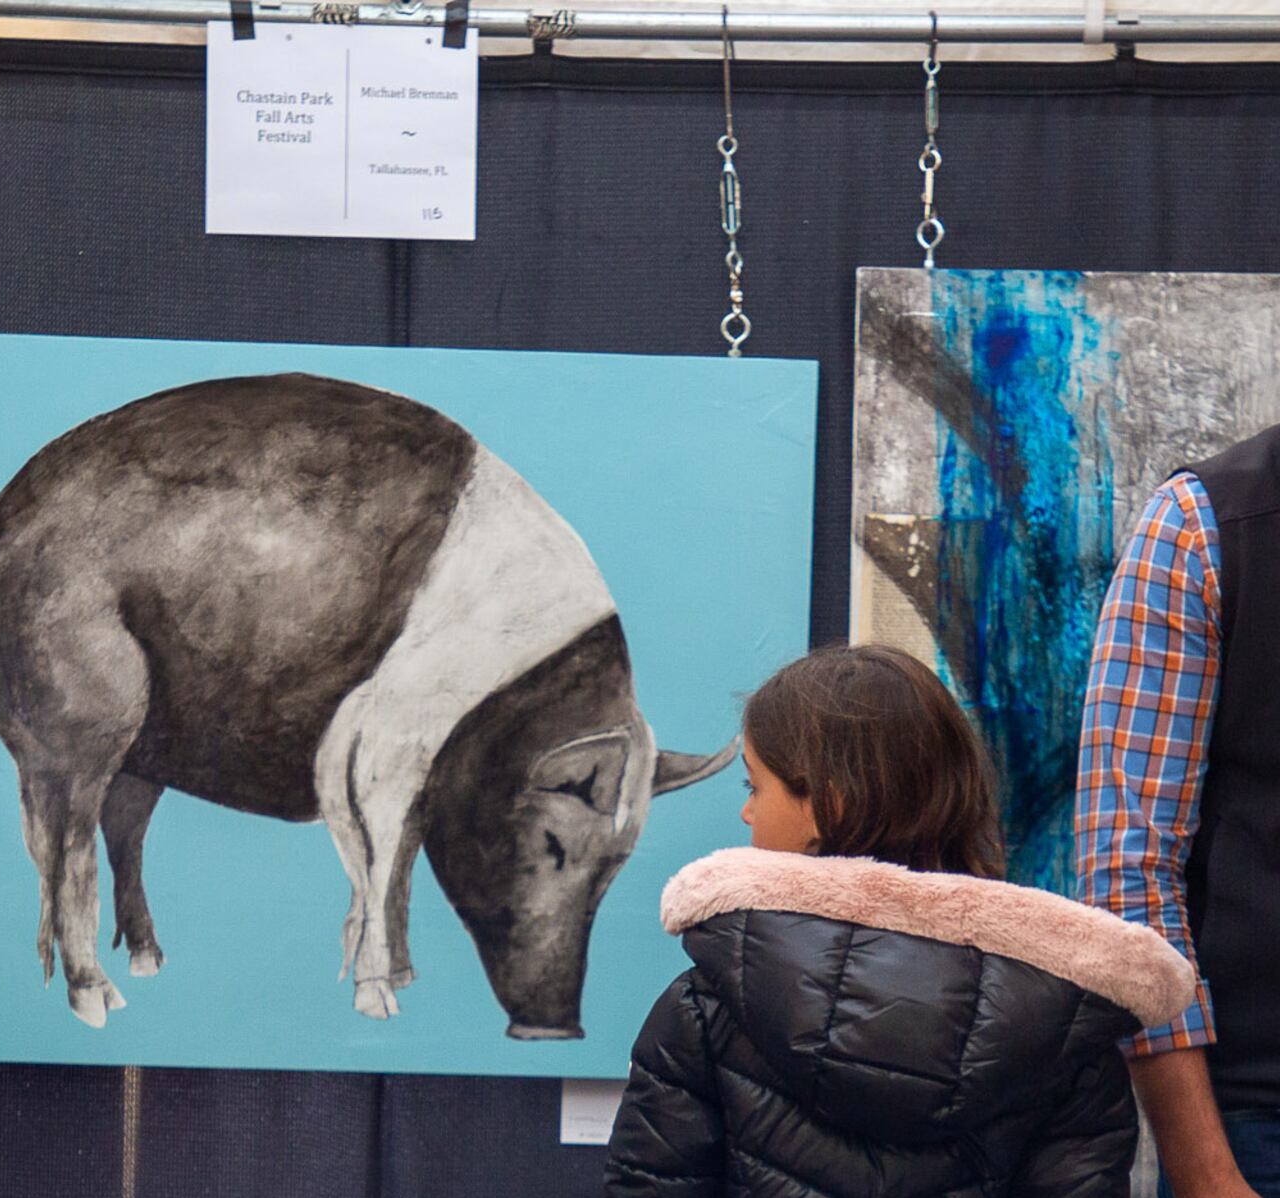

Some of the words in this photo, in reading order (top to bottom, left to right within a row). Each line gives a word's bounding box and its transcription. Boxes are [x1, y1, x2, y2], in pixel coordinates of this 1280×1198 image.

[236, 89, 297, 105] Chastain
[300, 91, 334, 106] Park
[360, 87, 406, 99] Michael
[408, 88, 459, 100] Brennan
[255, 110, 281, 124] Fall
[283, 111, 315, 125] Arts
[257, 129, 312, 143] Festival
[434, 165, 449, 176] FL
